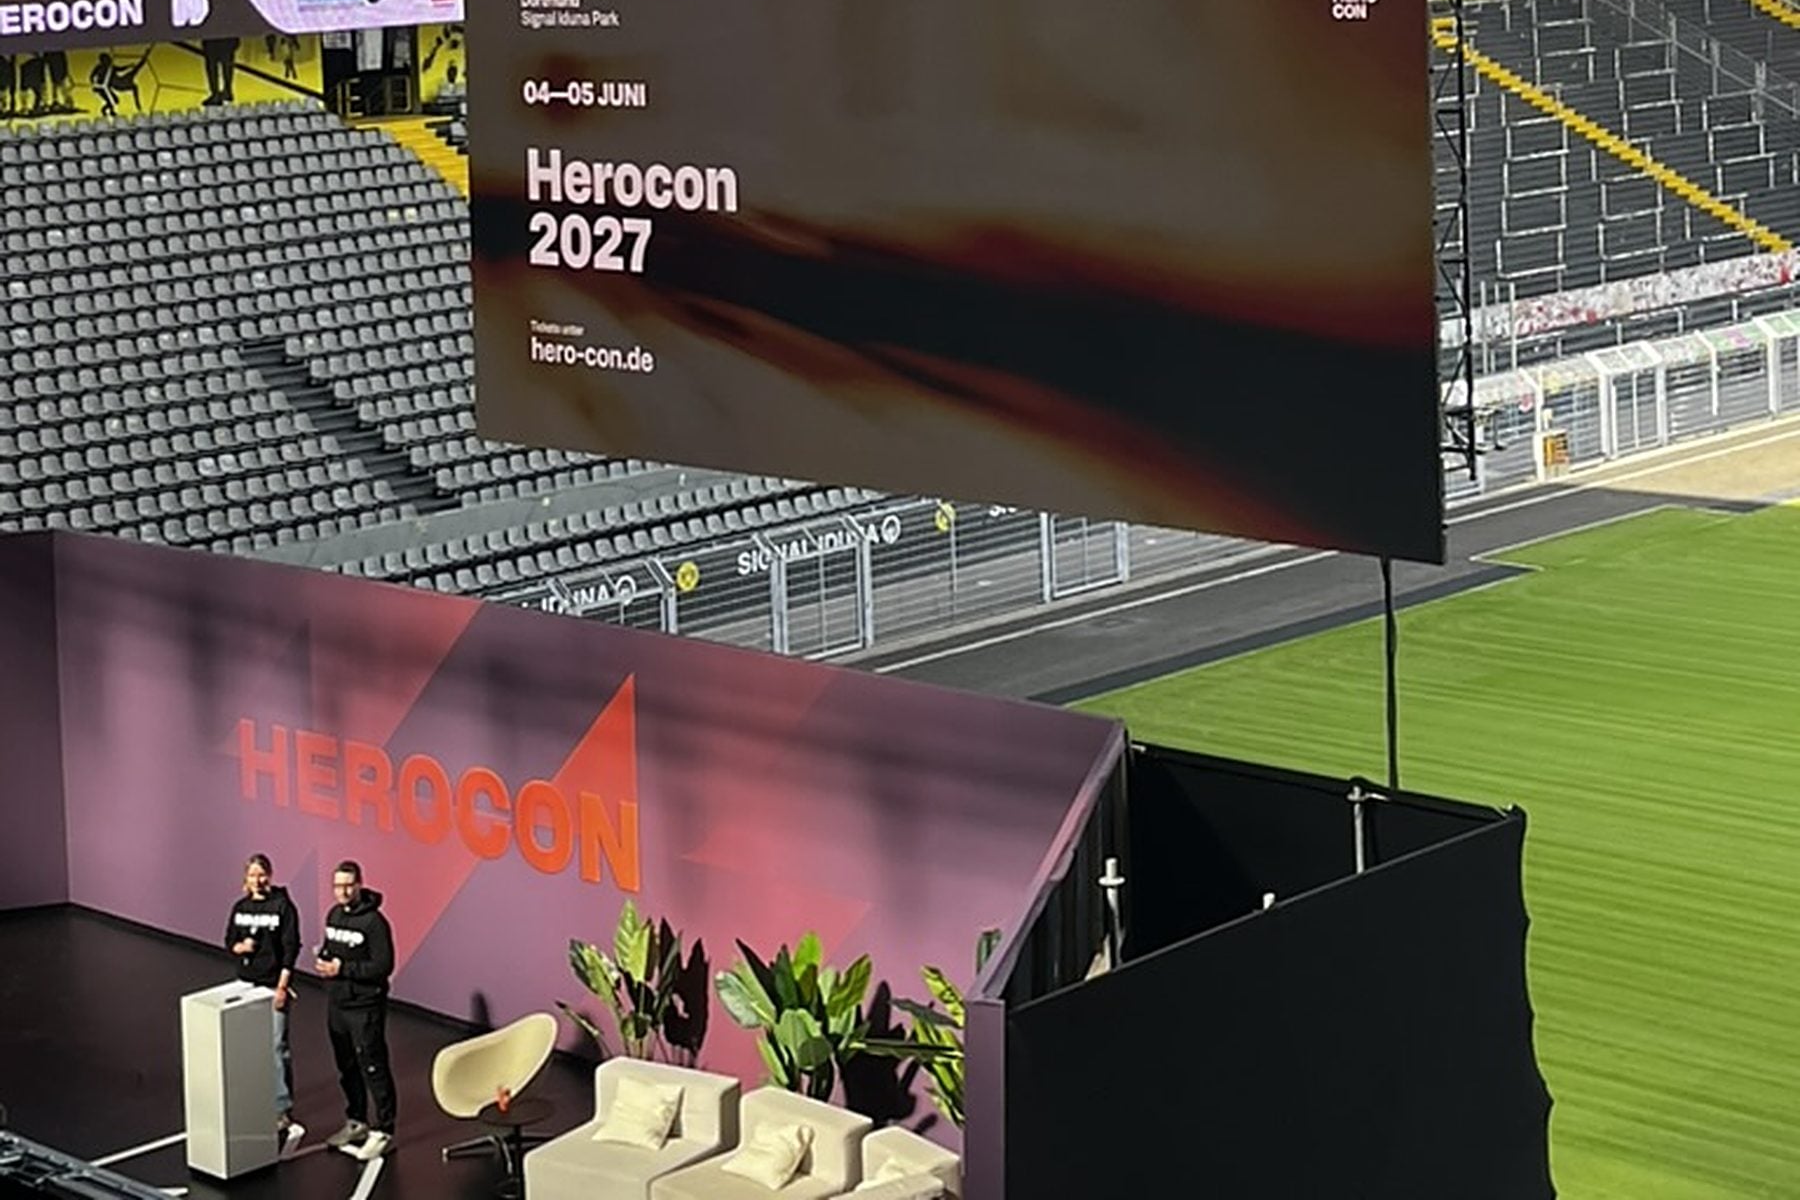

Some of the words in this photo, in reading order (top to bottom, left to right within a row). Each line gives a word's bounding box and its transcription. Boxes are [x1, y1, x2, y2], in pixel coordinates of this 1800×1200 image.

[520, 10, 556, 29] Signal
[558, 10, 590, 27] Iduna
[592, 10, 620, 27] Park
[1332, 3, 1368, 20] CON
[597, 82, 647, 107] JUNI
[527, 147, 738, 213] Herocon
[529, 211, 653, 273] 2027
[530, 336, 655, 373] hero-con.de
[238, 718, 640, 895] HEROCON
